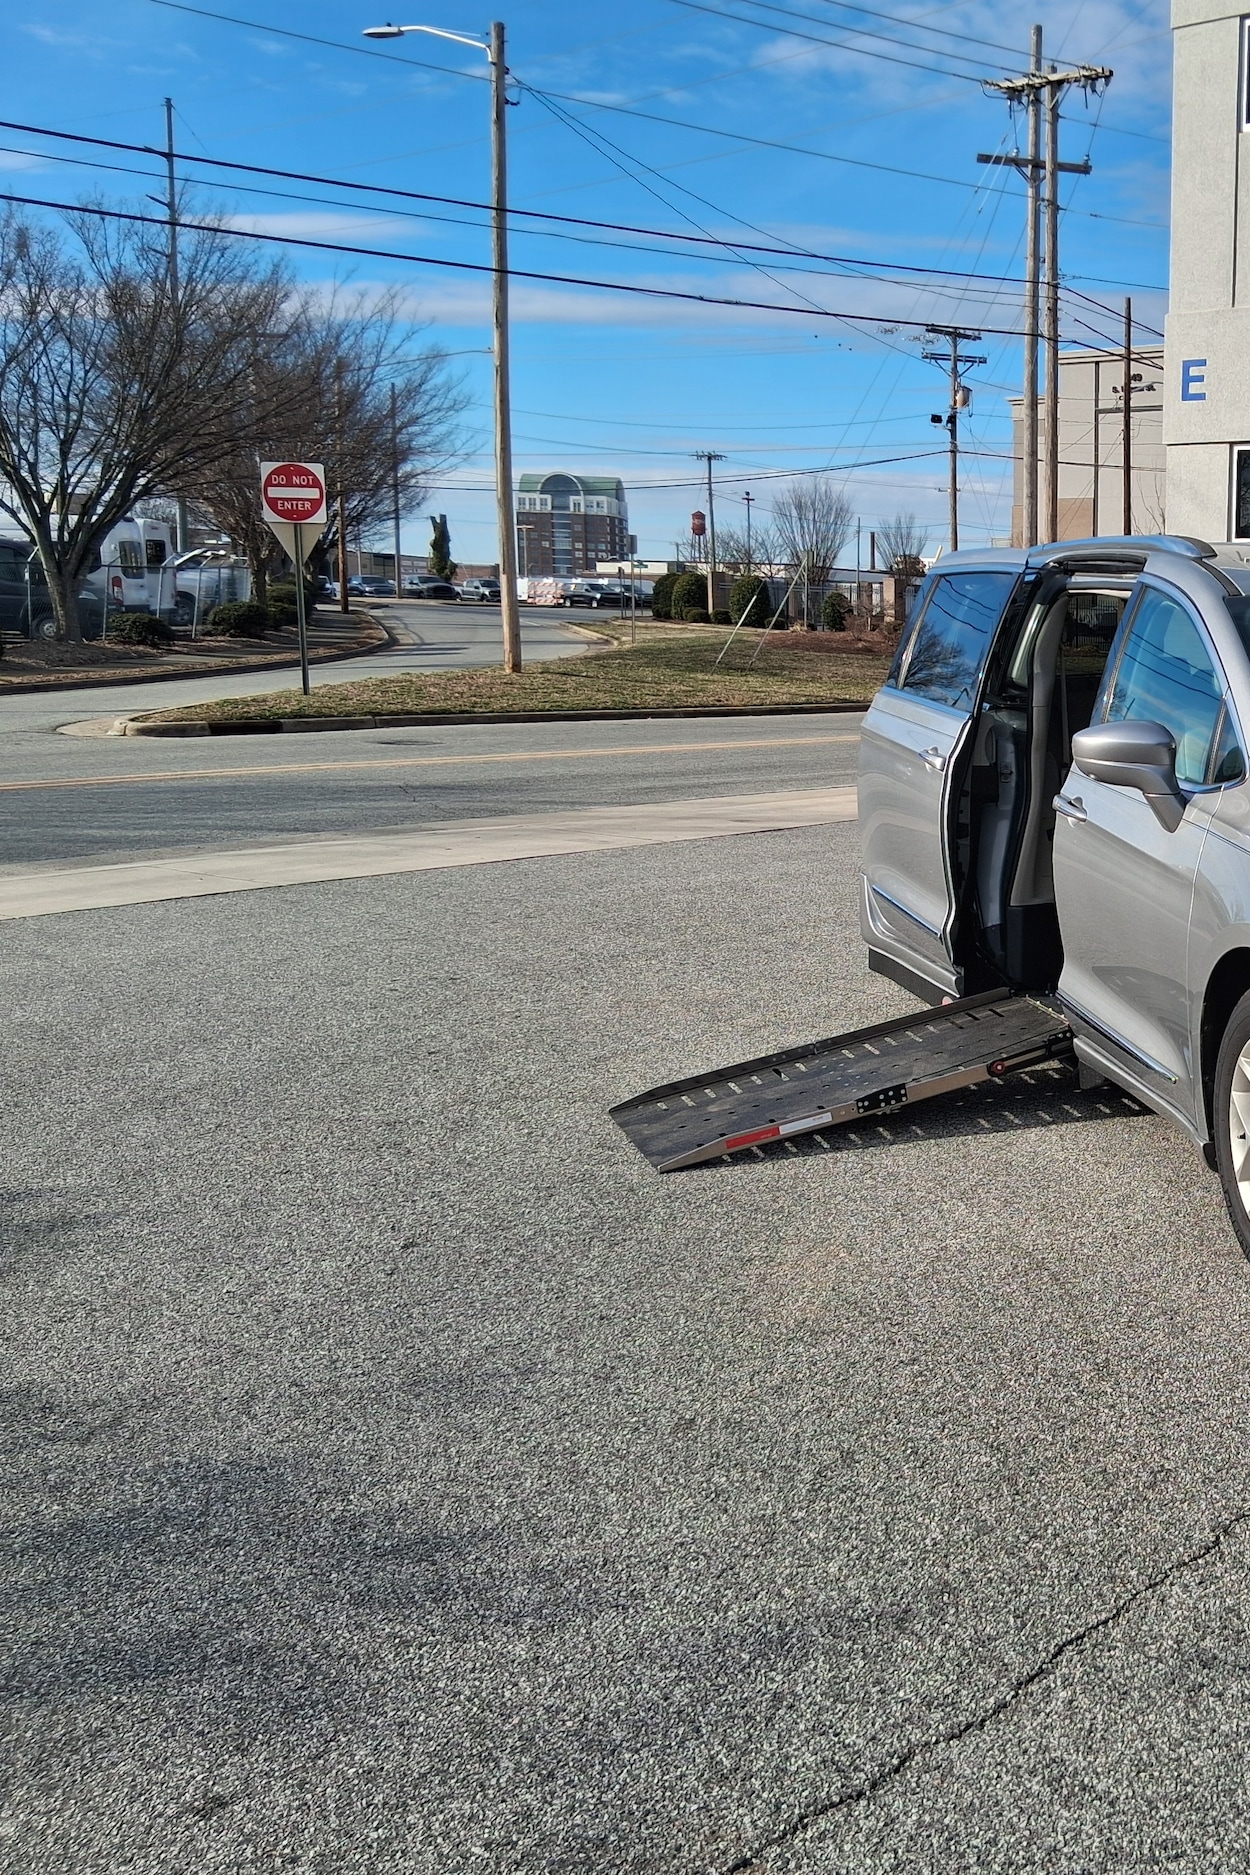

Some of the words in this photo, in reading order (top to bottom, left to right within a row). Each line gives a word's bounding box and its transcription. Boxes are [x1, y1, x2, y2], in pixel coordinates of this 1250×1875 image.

[1182, 359, 1206, 401] E
[272, 475, 286, 484] DO
[292, 475, 314, 485] NOT
[277, 500, 311, 510] ENTER
